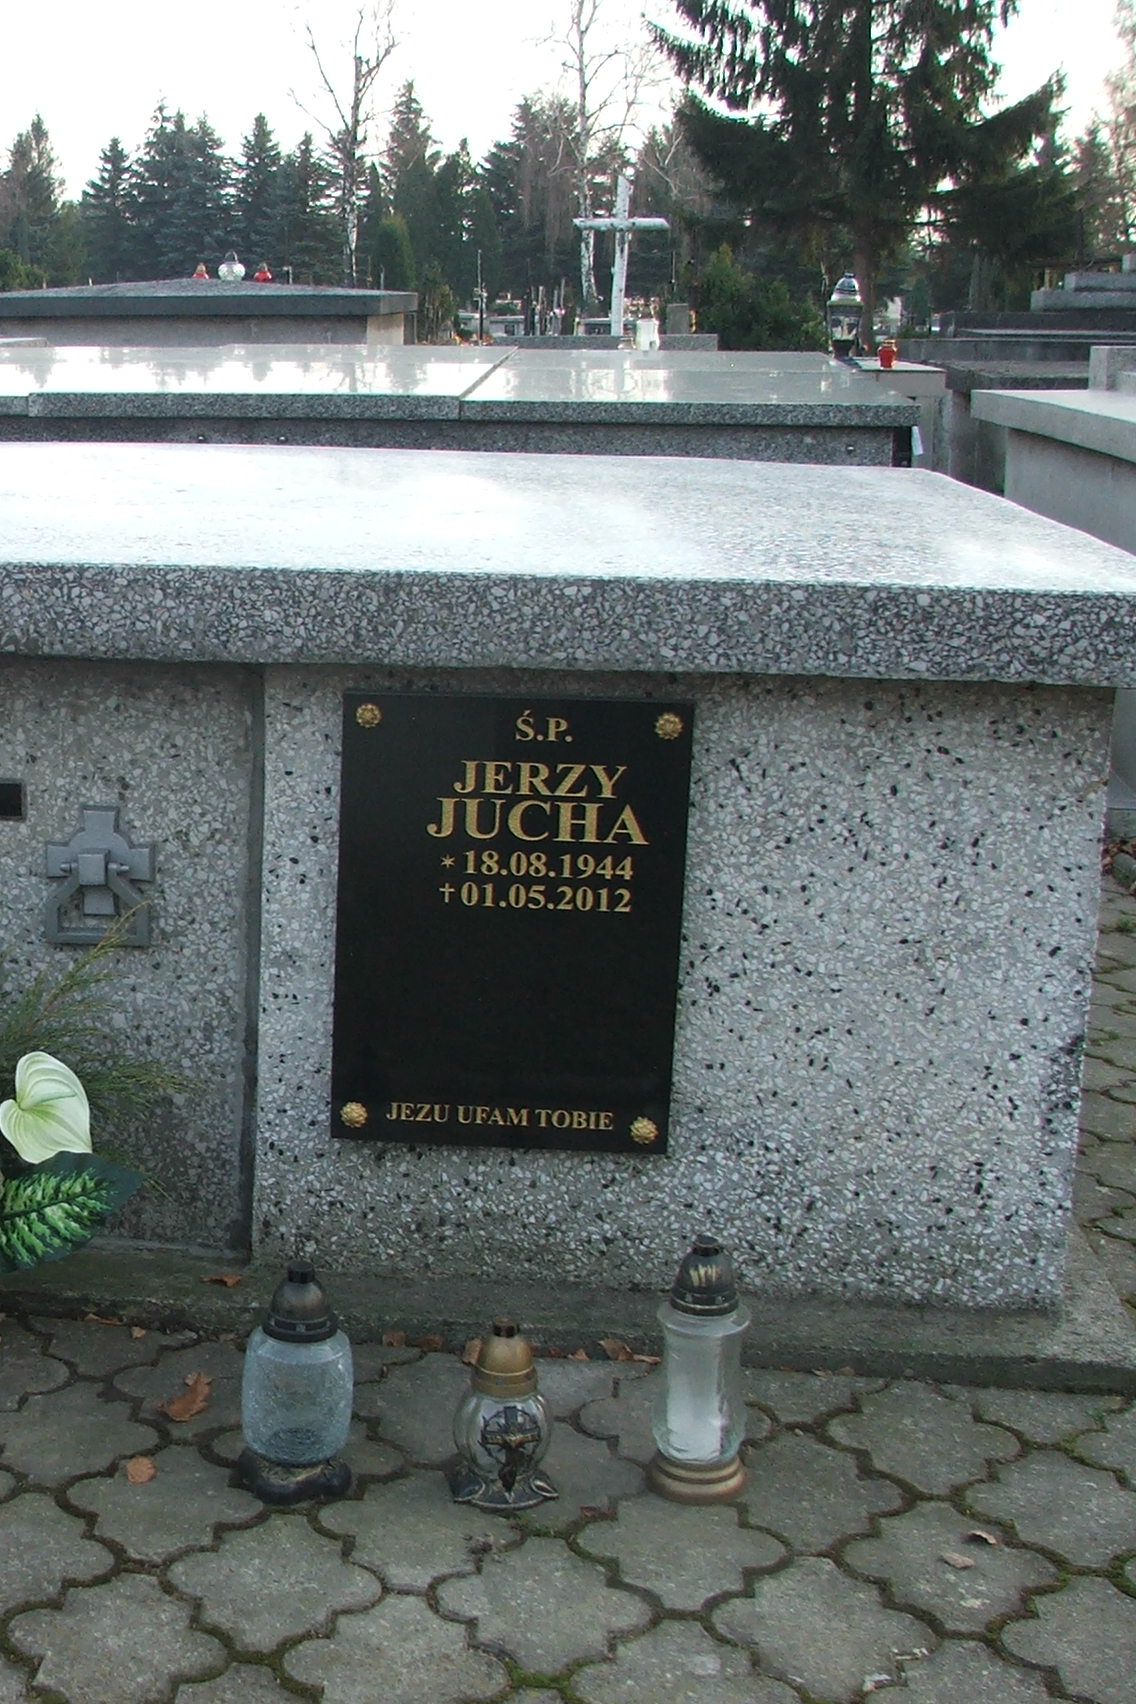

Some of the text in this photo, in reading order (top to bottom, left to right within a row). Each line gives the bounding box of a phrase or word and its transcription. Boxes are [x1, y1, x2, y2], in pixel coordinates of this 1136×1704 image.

[515, 710, 573, 742] Ś.P.
[452, 759, 628, 799] JERZY
[425, 797, 650, 846] JUCHA
[463, 849, 635, 882] 18.08.1944
[460, 881, 632, 914] 01.05.2012
[385, 1101, 615, 1132] JEZU UFAM TOBIE
